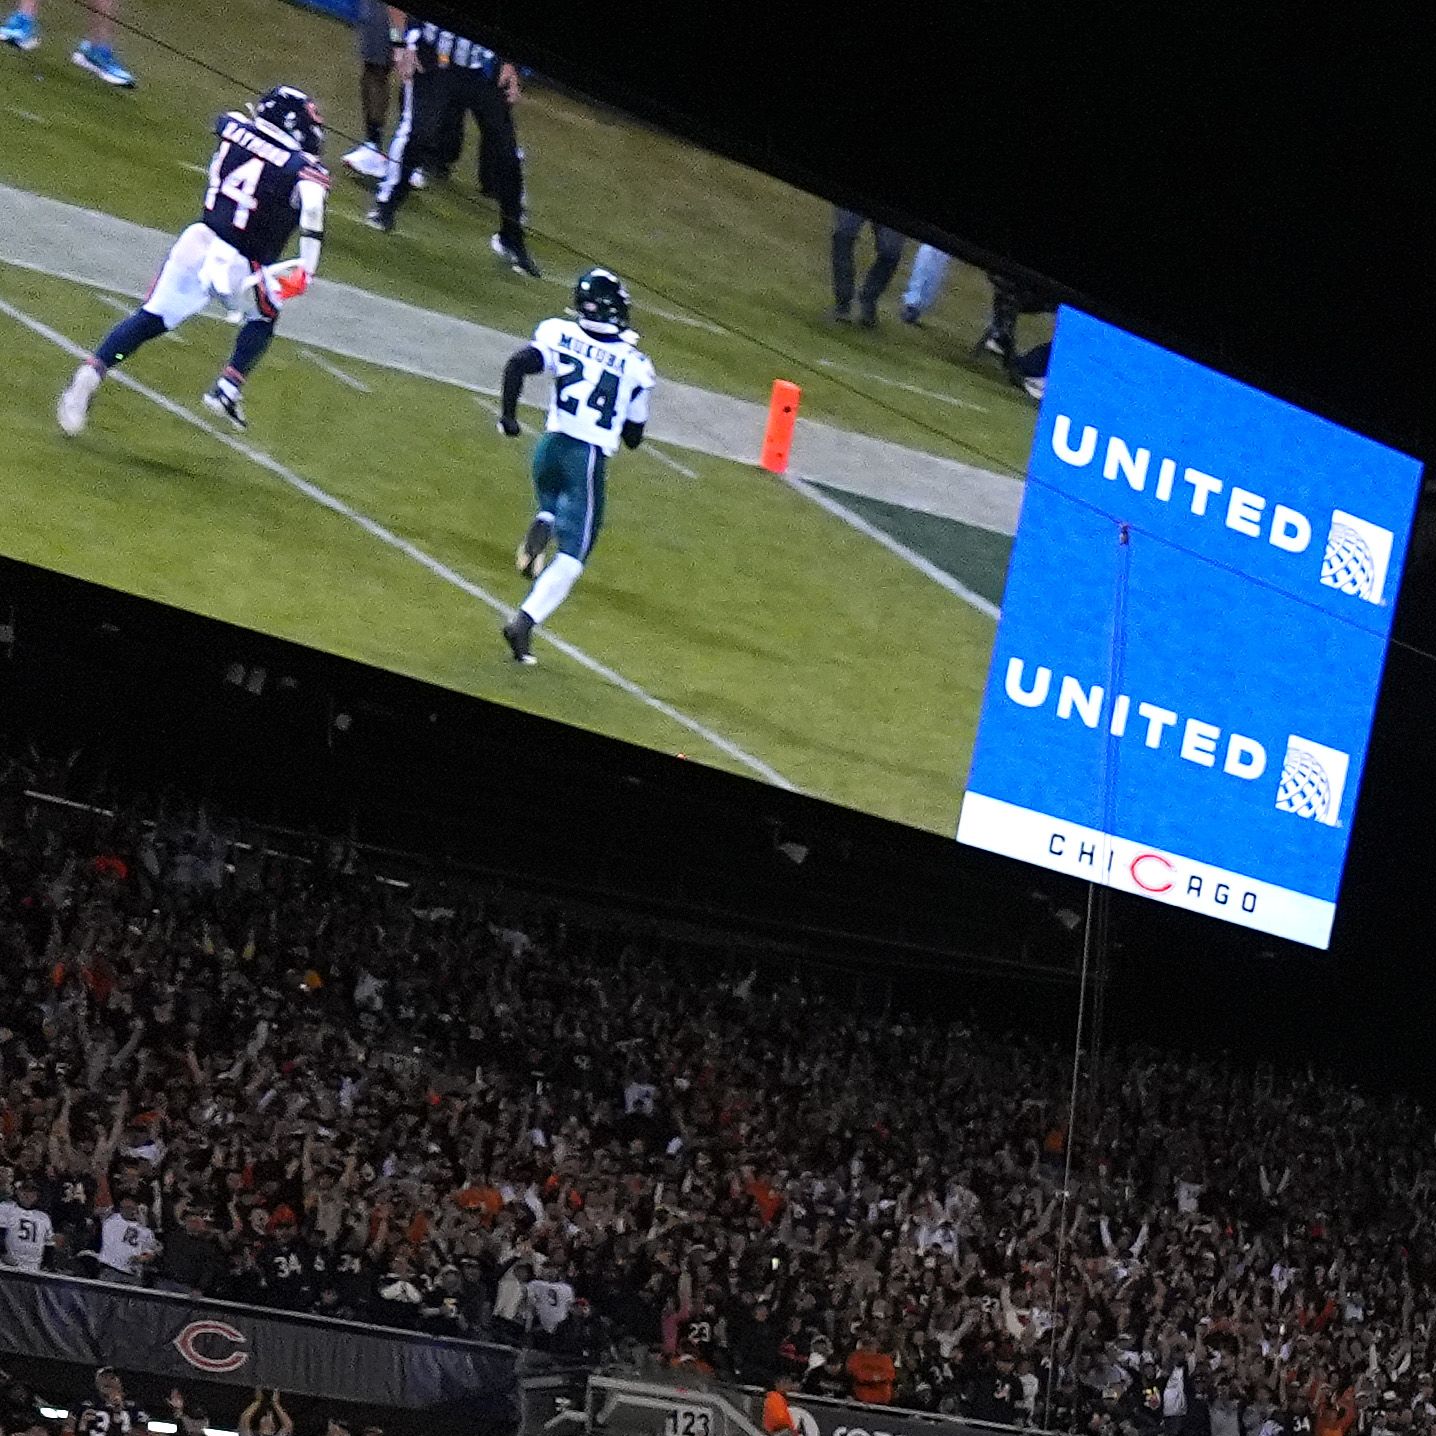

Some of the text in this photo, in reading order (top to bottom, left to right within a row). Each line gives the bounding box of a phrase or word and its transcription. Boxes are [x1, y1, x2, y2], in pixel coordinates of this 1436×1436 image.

[205, 141, 265, 231] 14
[556, 352, 620, 430] 24
[1052, 415, 1312, 554] UNITED
[1005, 656, 1267, 781] UNITED
[1048, 833, 1258, 914] CHICAGO
[18, 1219, 36, 1243] 51
